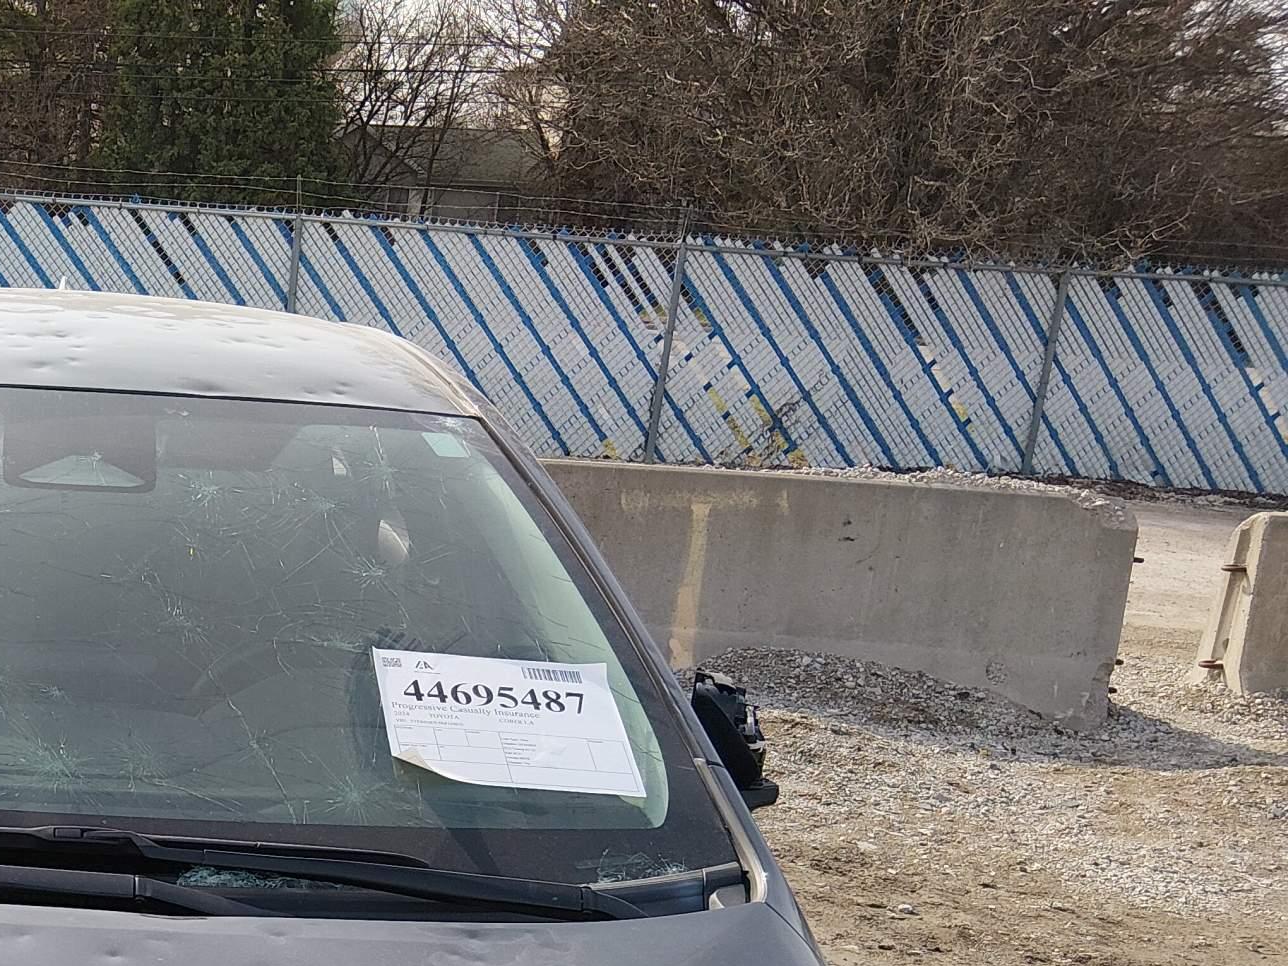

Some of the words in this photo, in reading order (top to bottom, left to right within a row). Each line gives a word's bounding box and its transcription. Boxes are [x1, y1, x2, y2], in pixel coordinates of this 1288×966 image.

[391, 701, 448, 713] Progressive
[449, 705, 491, 717] Casualty
[494, 708, 540, 719] Insurance
[403, 679, 585, 715] 44695487
